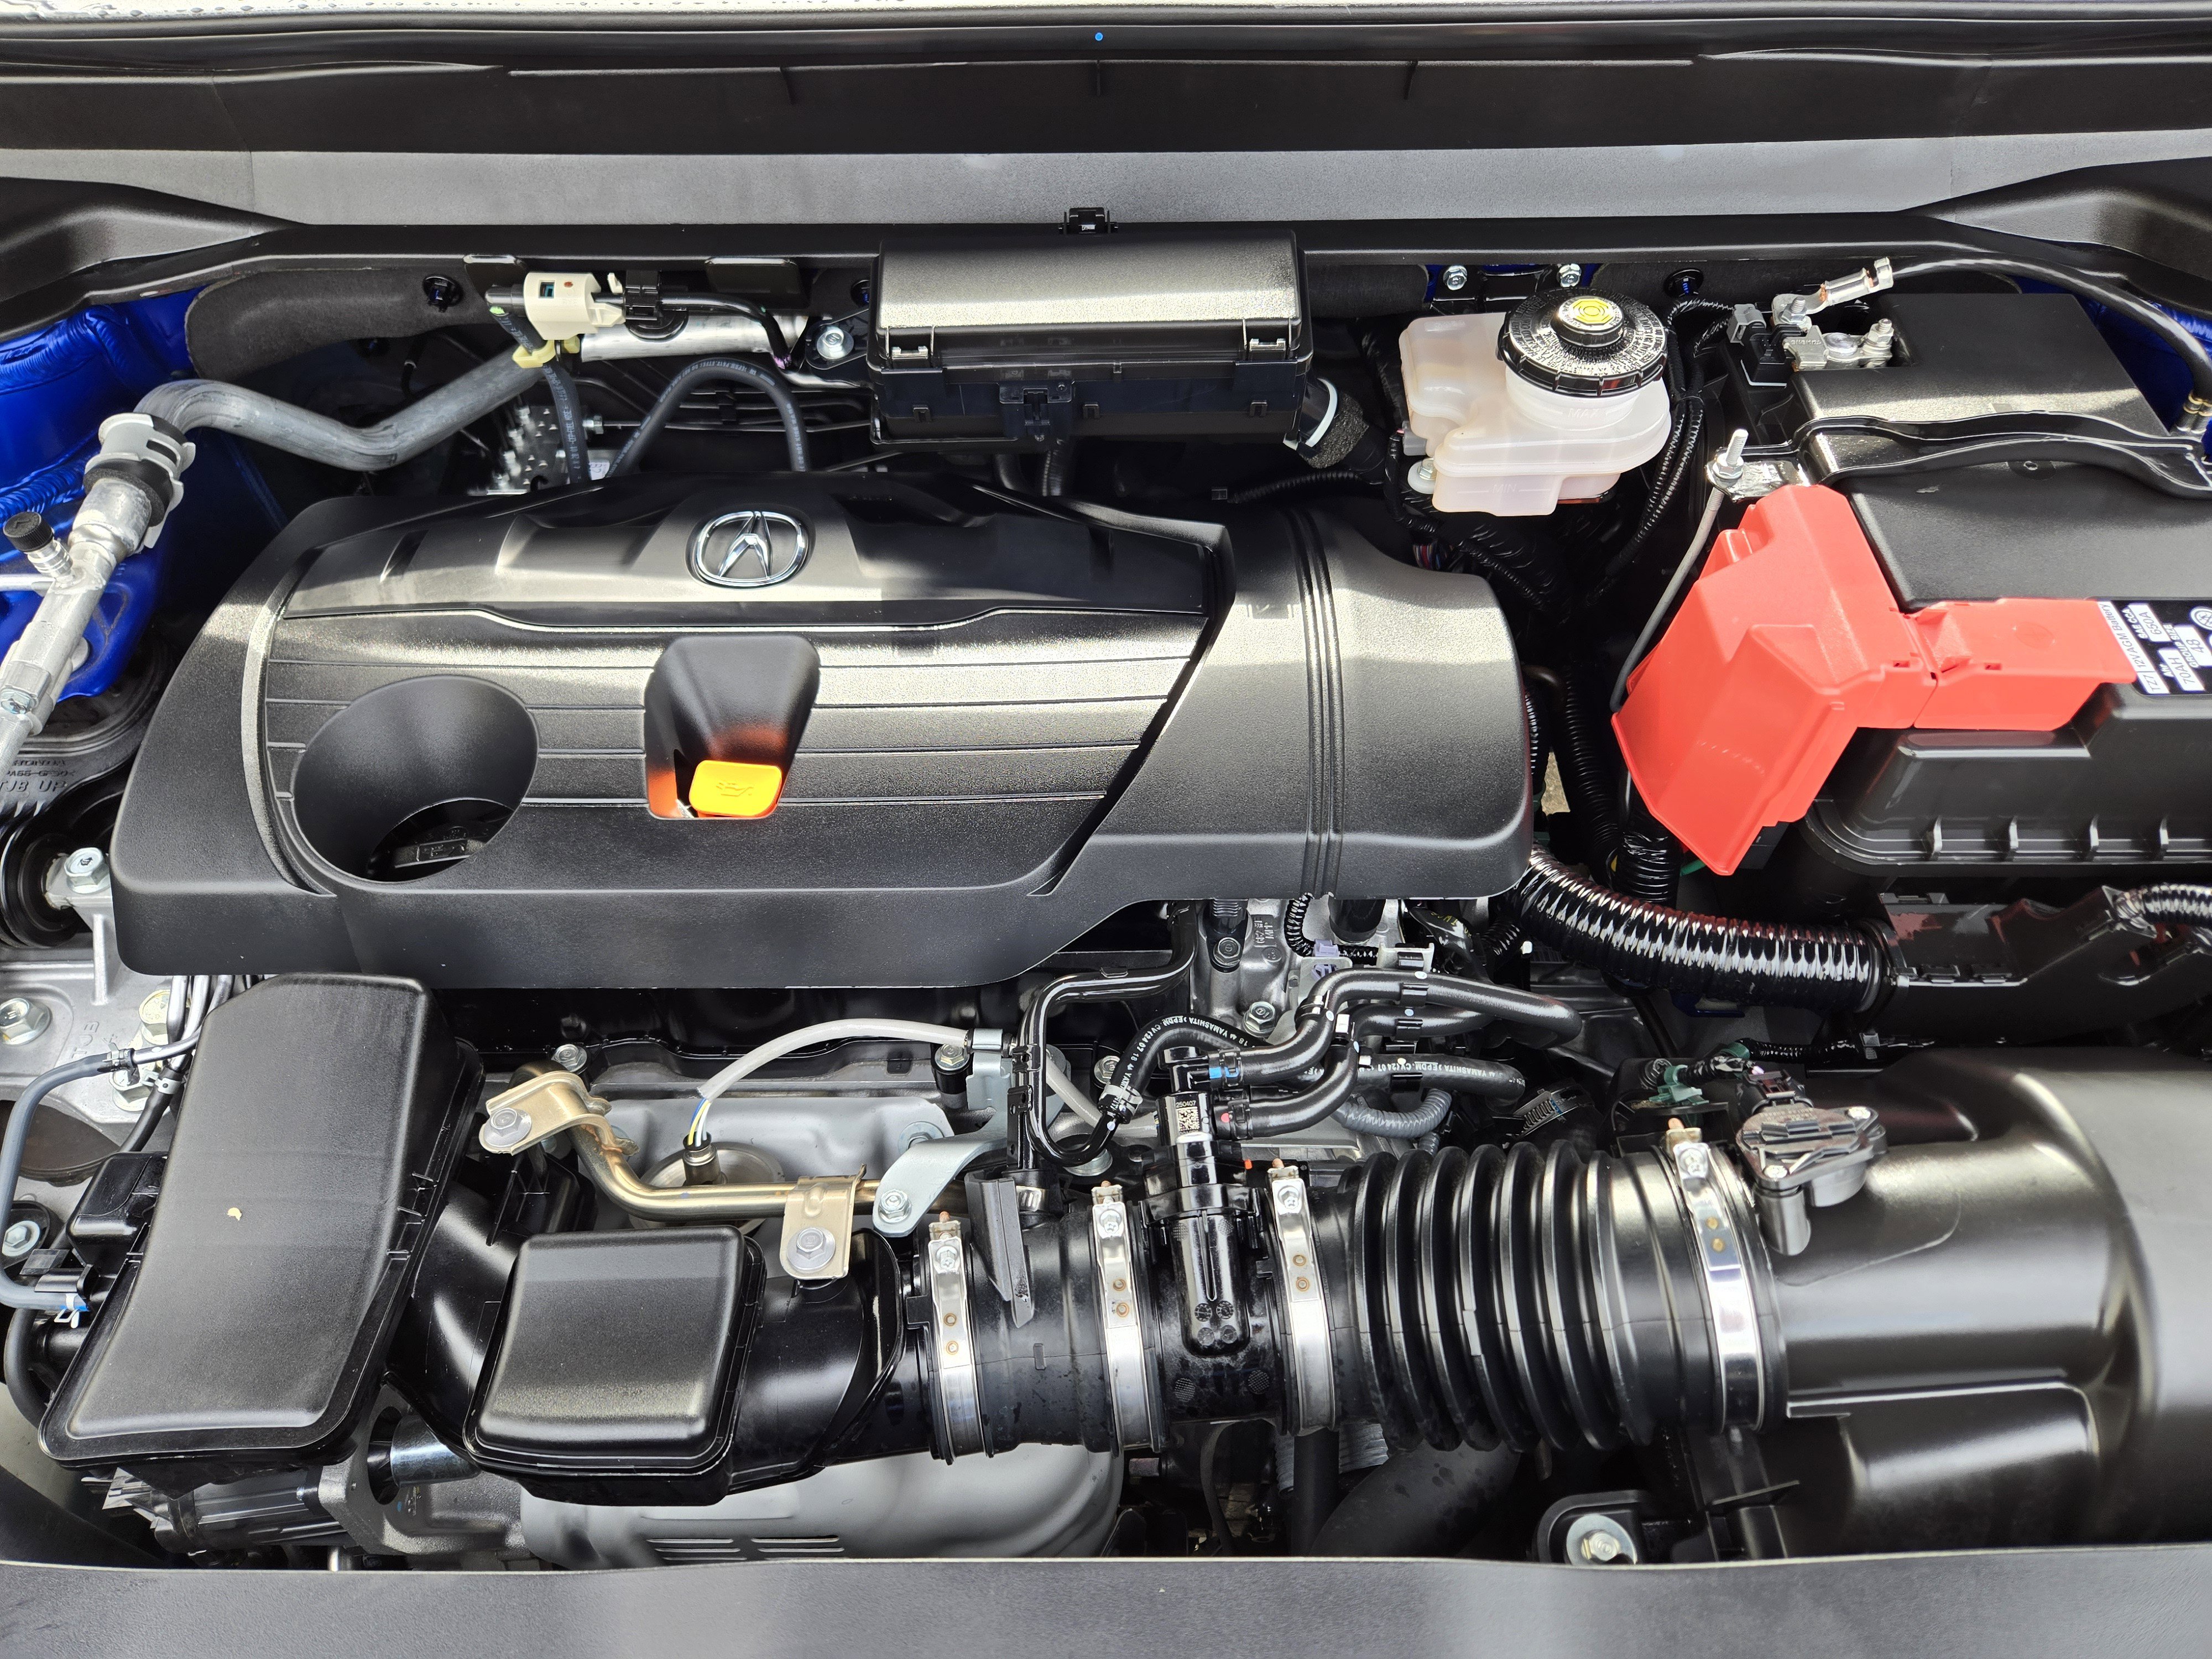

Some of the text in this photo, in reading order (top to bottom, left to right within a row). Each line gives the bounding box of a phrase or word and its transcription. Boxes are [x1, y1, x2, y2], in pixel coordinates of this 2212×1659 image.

[1492, 483, 1517, 494] MIN
[2099, 603, 2124, 631] Battery
[2121, 608, 2149, 639] SAE CCA
[2138, 612, 2163, 635] 650A
[2163, 624, 2200, 669] GROUP SIZE
[2185, 638, 2205, 654] 48
[2168, 657, 2196, 685] 70AH
[2143, 674, 2161, 691] TZ7
[39, 780, 66, 792] UP
[1188, 1016, 1228, 1038] YAMASHITA
[1444, 1064, 1487, 1077] YAMASHITA
[1175, 1100, 1197, 1108] 250407
